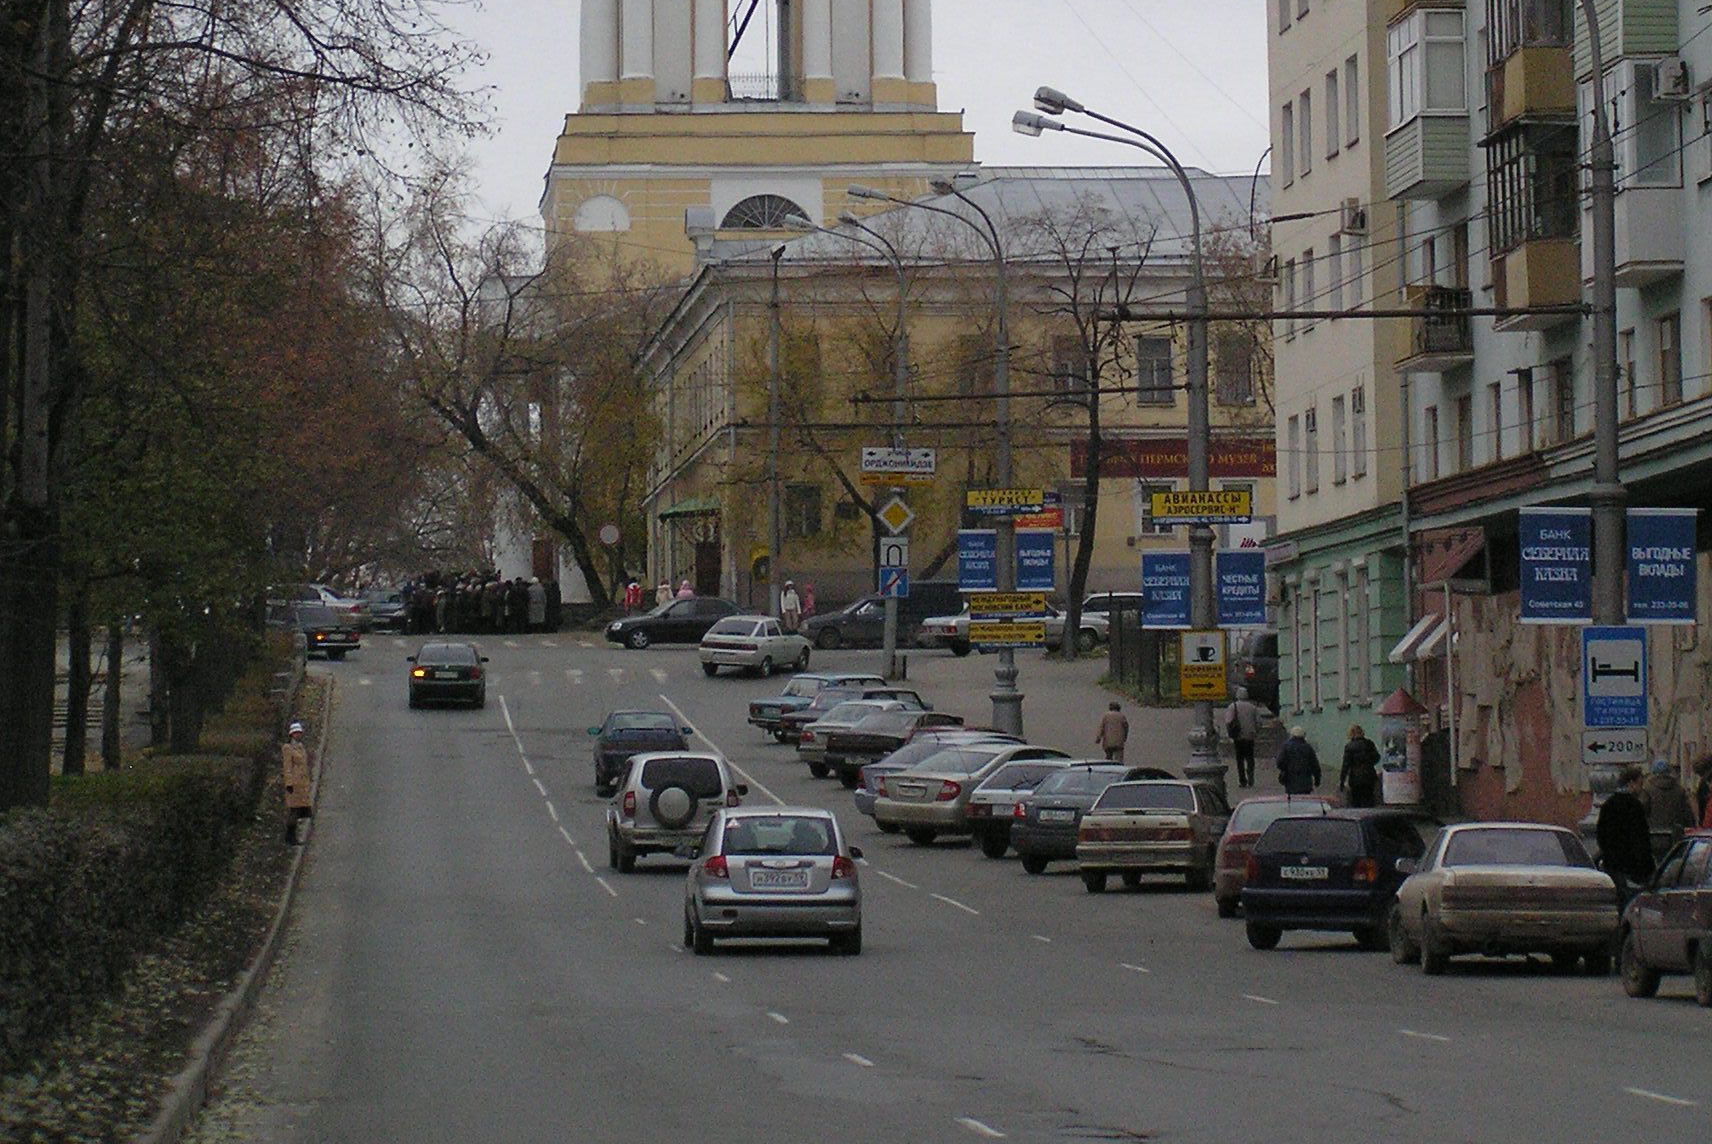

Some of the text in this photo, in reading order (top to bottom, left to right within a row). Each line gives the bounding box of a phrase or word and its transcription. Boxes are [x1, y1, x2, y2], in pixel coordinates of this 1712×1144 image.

[1540, 529, 1572, 540] БАНК
[1522, 547, 1590, 561] СЕВЕРНАЯ
[1631, 547, 1692, 562] ВЫГОДНЫЕ
[1155, 563, 1177, 573] БАНК
[1534, 567, 1578, 581] КАЗНА
[1638, 563, 1685, 578] ВКЛАДЫ
